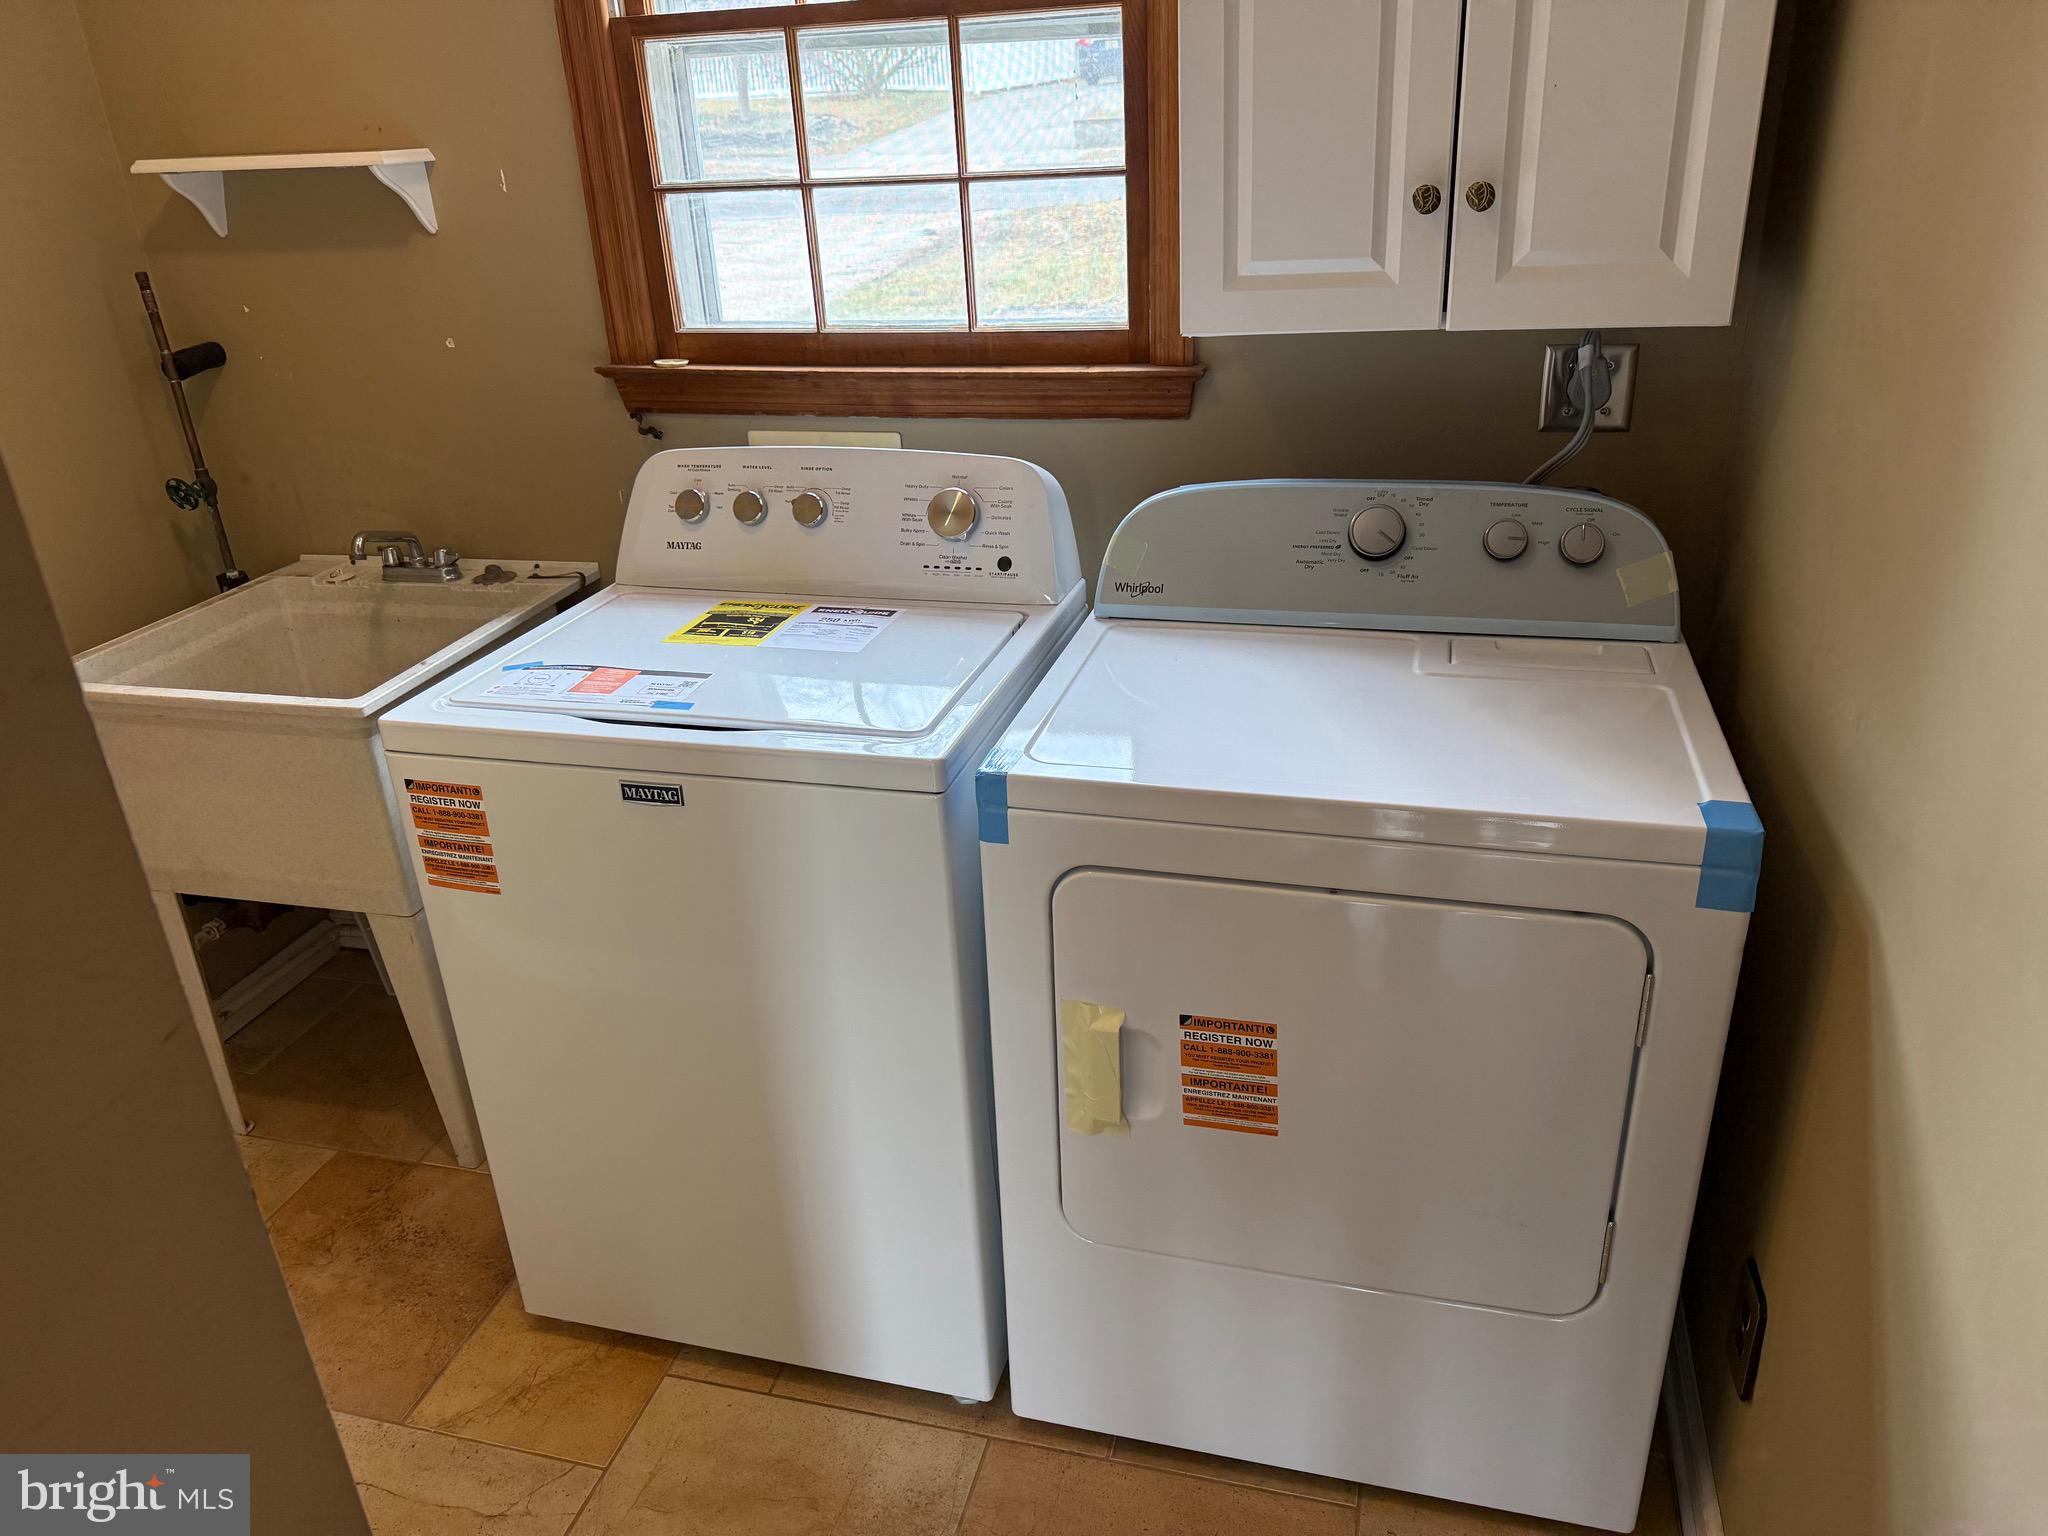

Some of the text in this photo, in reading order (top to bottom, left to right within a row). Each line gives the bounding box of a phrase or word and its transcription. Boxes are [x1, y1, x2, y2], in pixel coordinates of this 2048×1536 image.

[666, 541, 702, 550] MAYTAG
[1115, 582, 1164, 598] Whirlpool
[415, 782, 472, 796] IMPORTANT!
[623, 786, 678, 801] MAYTAG
[410, 794, 481, 809] REGISTER NOW
[412, 806, 483, 820] CALL 1-888-900-3381
[423, 839, 485, 853] IMPORTANTE!
[421, 849, 493, 863] ENREGISTREZ MAINTENANT
[1193, 1018, 1265, 1034] IMPORTANT!
[1184, 1031, 1274, 1048] REGISTER NOW
[1183, 1043, 1274, 1060] CALL 1-888-900-3381
[1190, 1077, 1268, 1095] IMPORTANTE!
[1183, 1088, 1277, 1104] ENREGISTREZ MAINTENANT
[1185, 1096, 1216, 1105] APPELEZ
